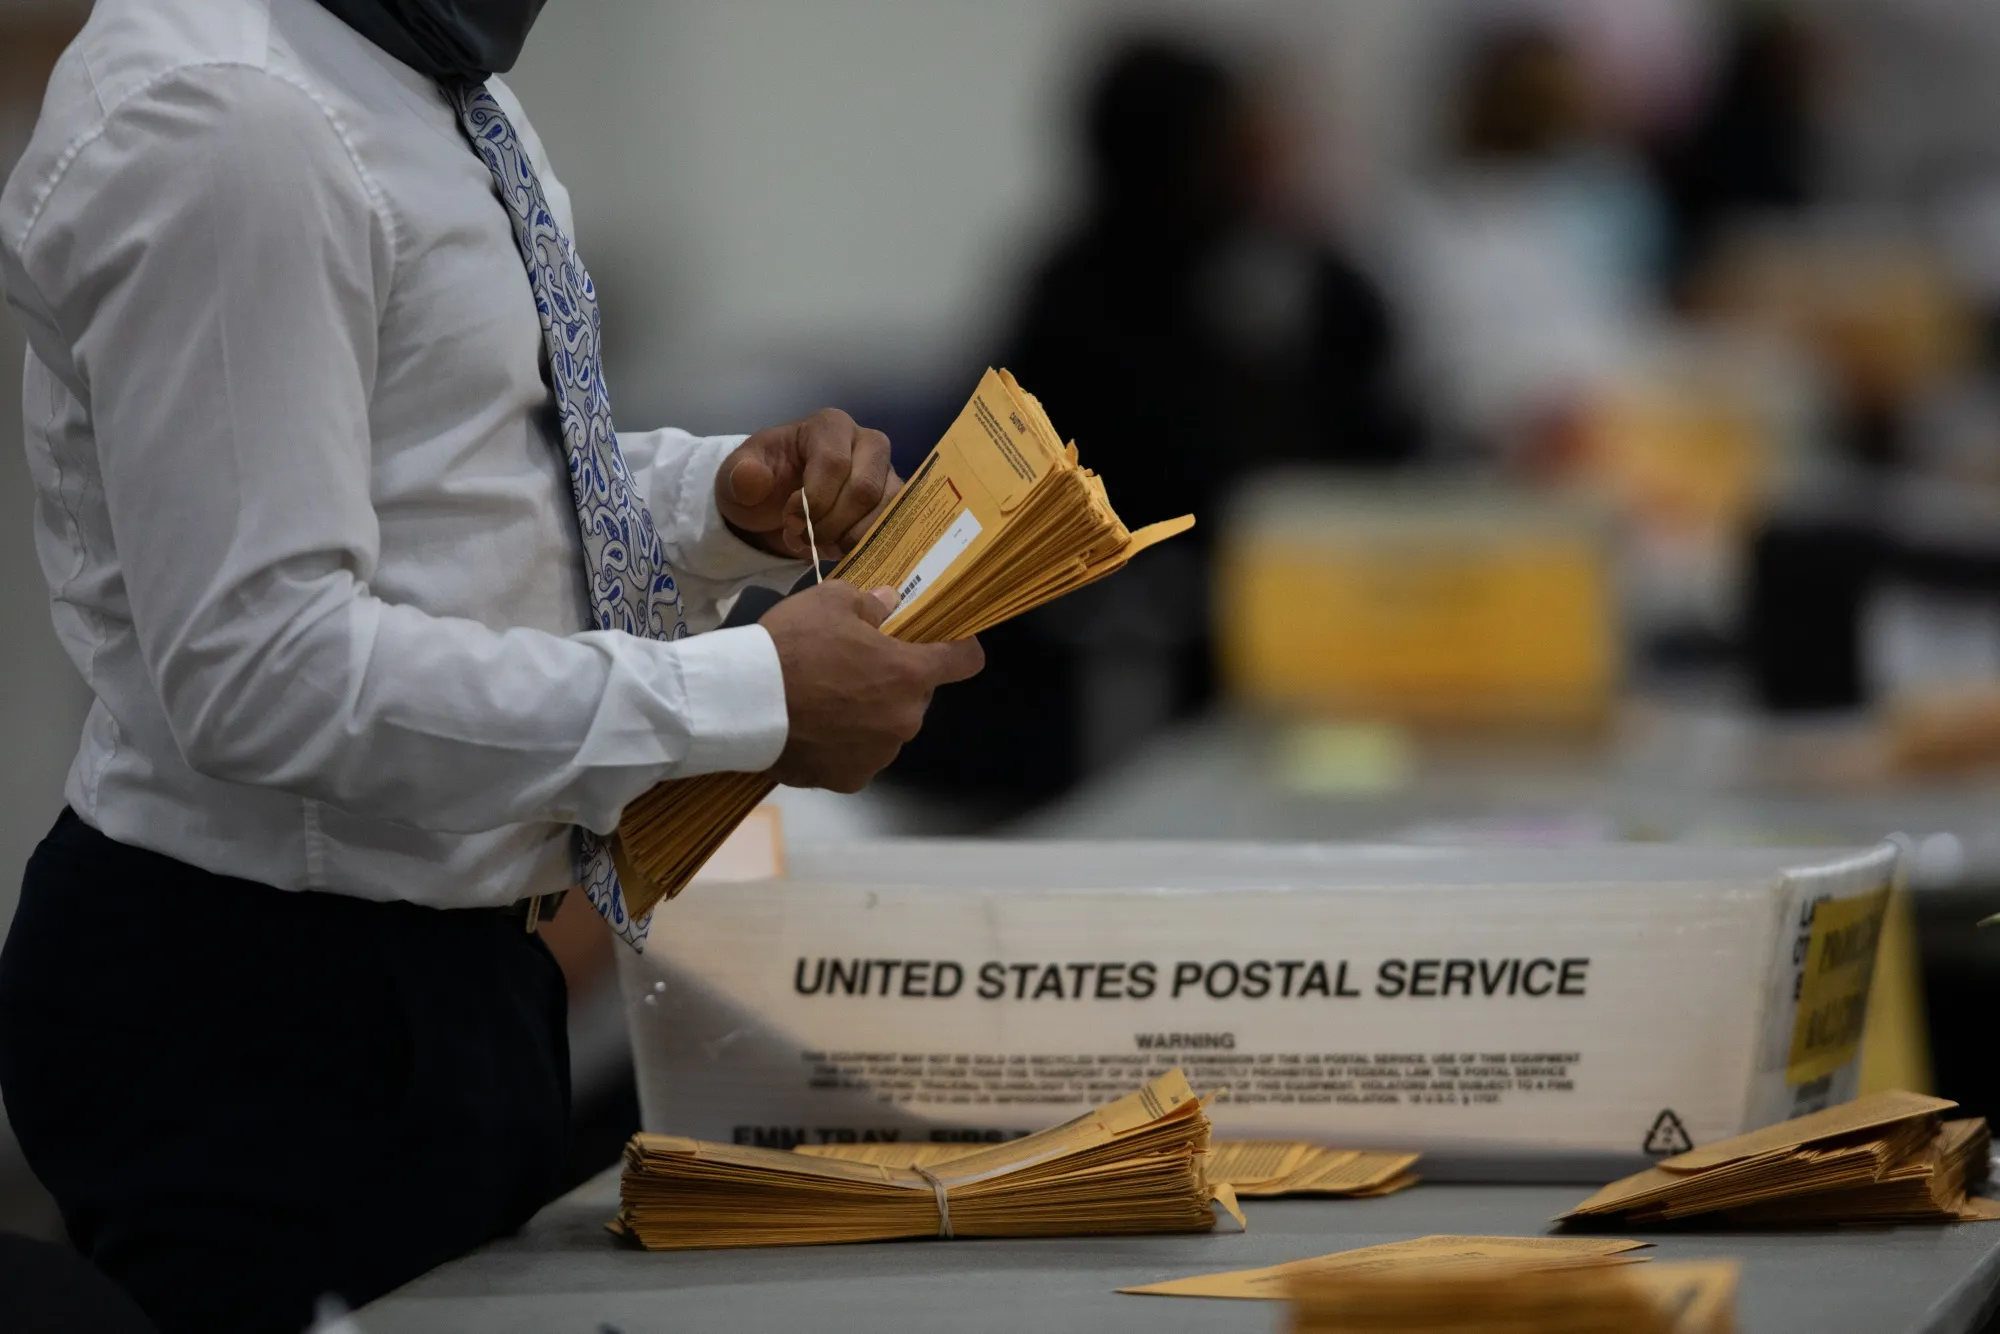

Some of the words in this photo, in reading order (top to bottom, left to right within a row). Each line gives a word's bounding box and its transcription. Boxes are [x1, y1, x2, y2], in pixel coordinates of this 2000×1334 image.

[794, 957, 964, 997] UNITED
[977, 961, 1158, 1000] STATES
[1172, 959, 1362, 999] POSTAL
[1375, 956, 1590, 998] SERVICE
[1135, 1031, 1236, 1049] WARNING
[1324, 1054, 1369, 1065] POSTAL
[1464, 1066, 1511, 1077] POSTAL
[1515, 1066, 1566, 1077] SERVICE
